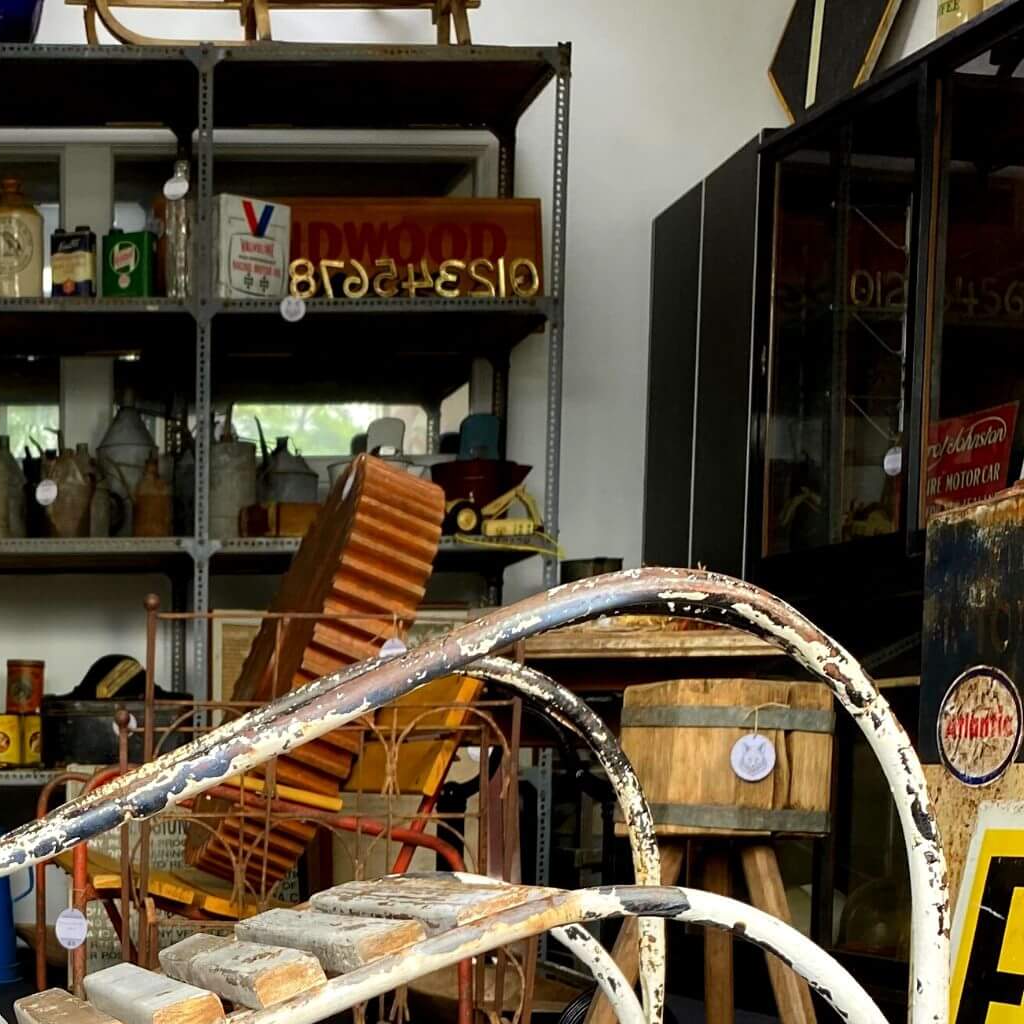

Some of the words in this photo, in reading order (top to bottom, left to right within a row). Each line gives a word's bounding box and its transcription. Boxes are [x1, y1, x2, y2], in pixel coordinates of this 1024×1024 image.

[944, 467, 981, 492] MOTOR
[981, 463, 1001, 484] CAR
[945, 704, 1014, 739] Atlantic
